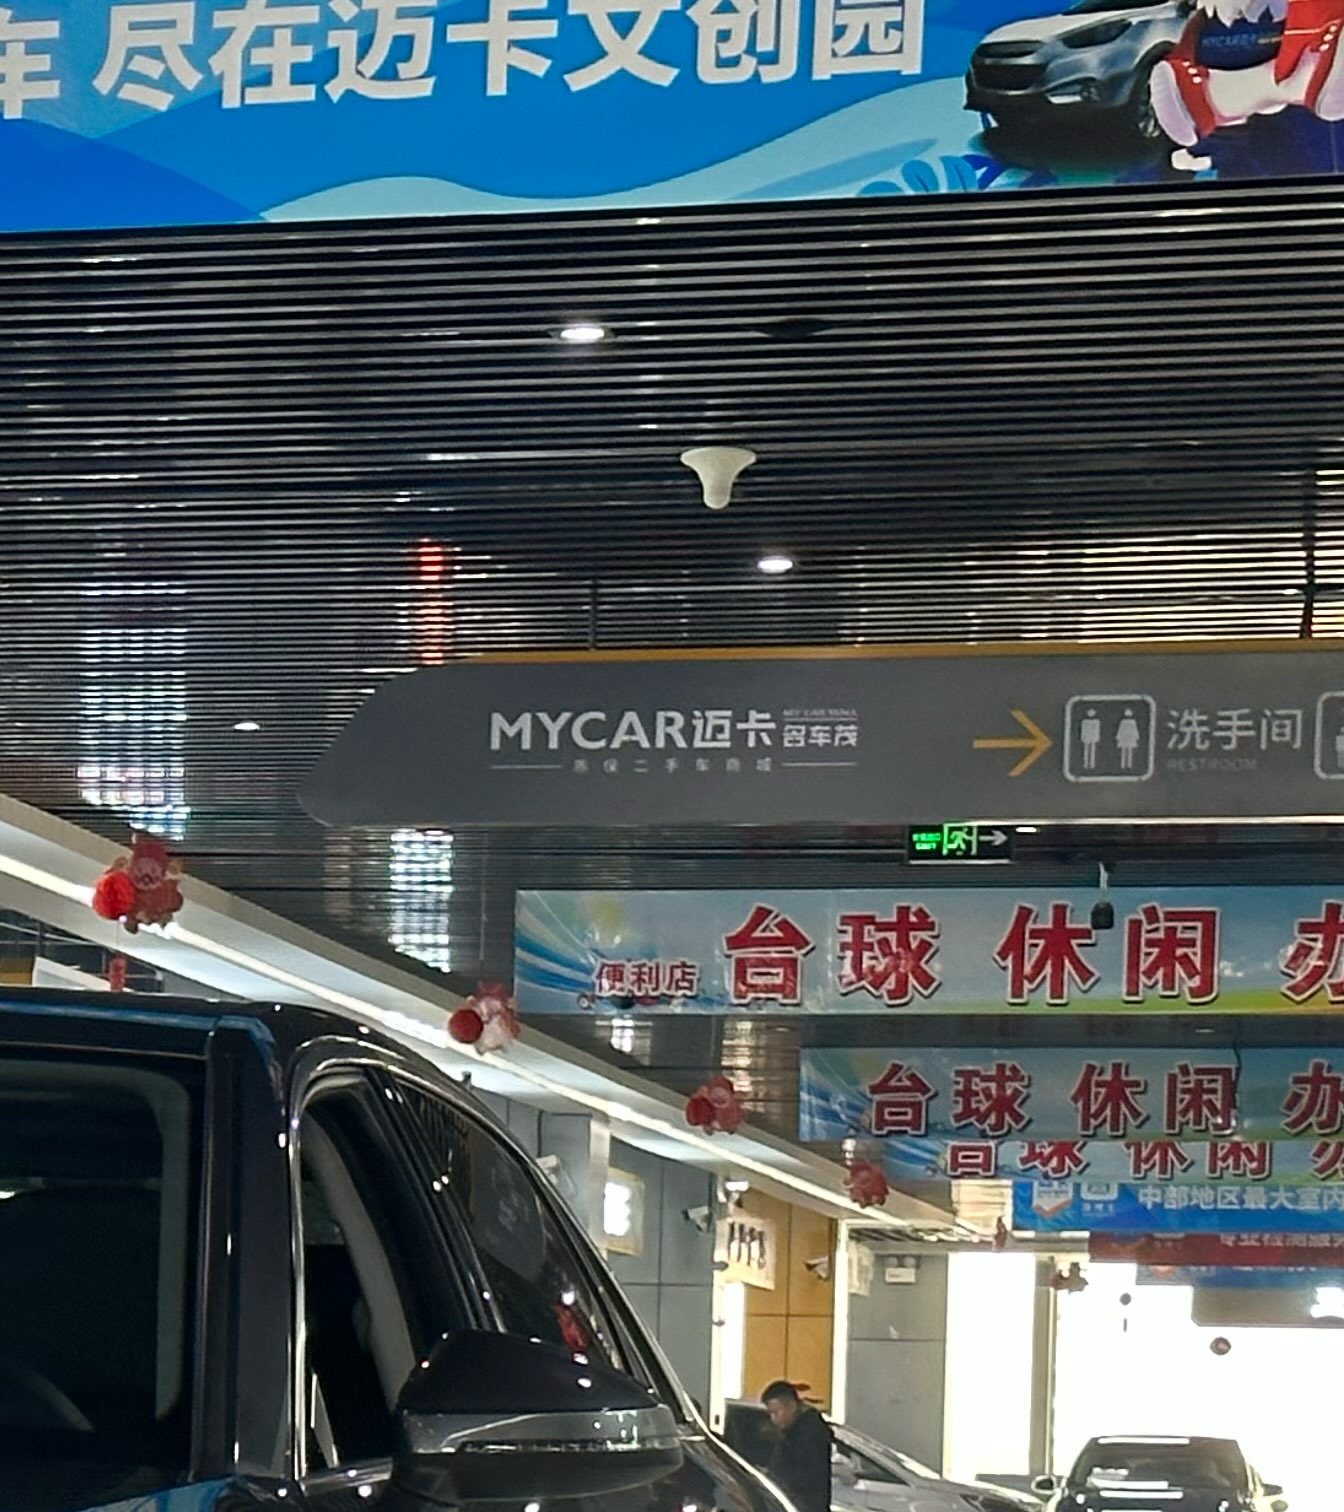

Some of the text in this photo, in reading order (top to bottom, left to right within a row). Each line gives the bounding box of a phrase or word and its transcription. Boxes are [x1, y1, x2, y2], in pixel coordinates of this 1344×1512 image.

[94, 0, 924, 110] 尽在迈卡文创园
[490, 709, 858, 751] MYCAR迈卡 名车茂
[1166, 707, 1305, 752] 洗手间
[1167, 758, 1256, 771] RESTROOM
[724, 903, 941, 1004] 台球
[995, 902, 1220, 1004] 休闲
[594, 958, 700, 998] 便利店
[868, 1062, 1030, 1136] 台球
[1071, 1061, 1239, 1136] 休闲
[1138, 1185, 1344, 1211] 中部地区最大室内
